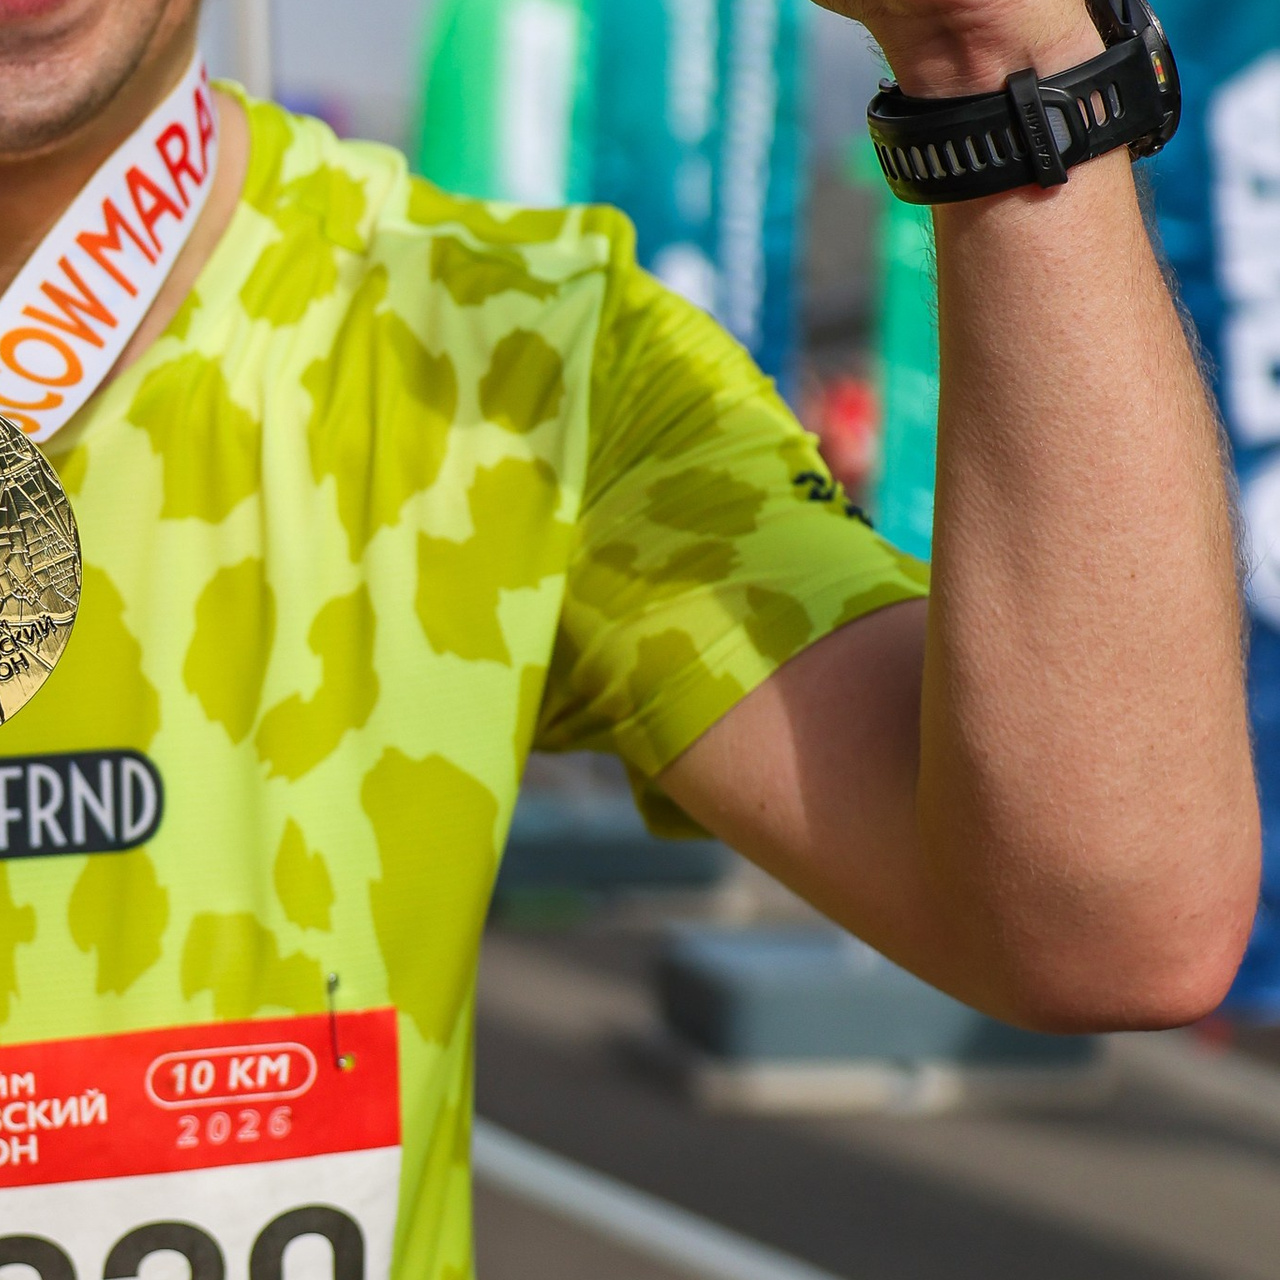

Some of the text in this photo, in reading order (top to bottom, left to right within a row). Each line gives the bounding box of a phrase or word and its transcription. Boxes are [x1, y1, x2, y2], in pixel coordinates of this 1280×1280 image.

[75, 63, 218, 301] MARA
[171, 1059, 216, 1096] 10
[175, 1105, 293, 1149] 2026
